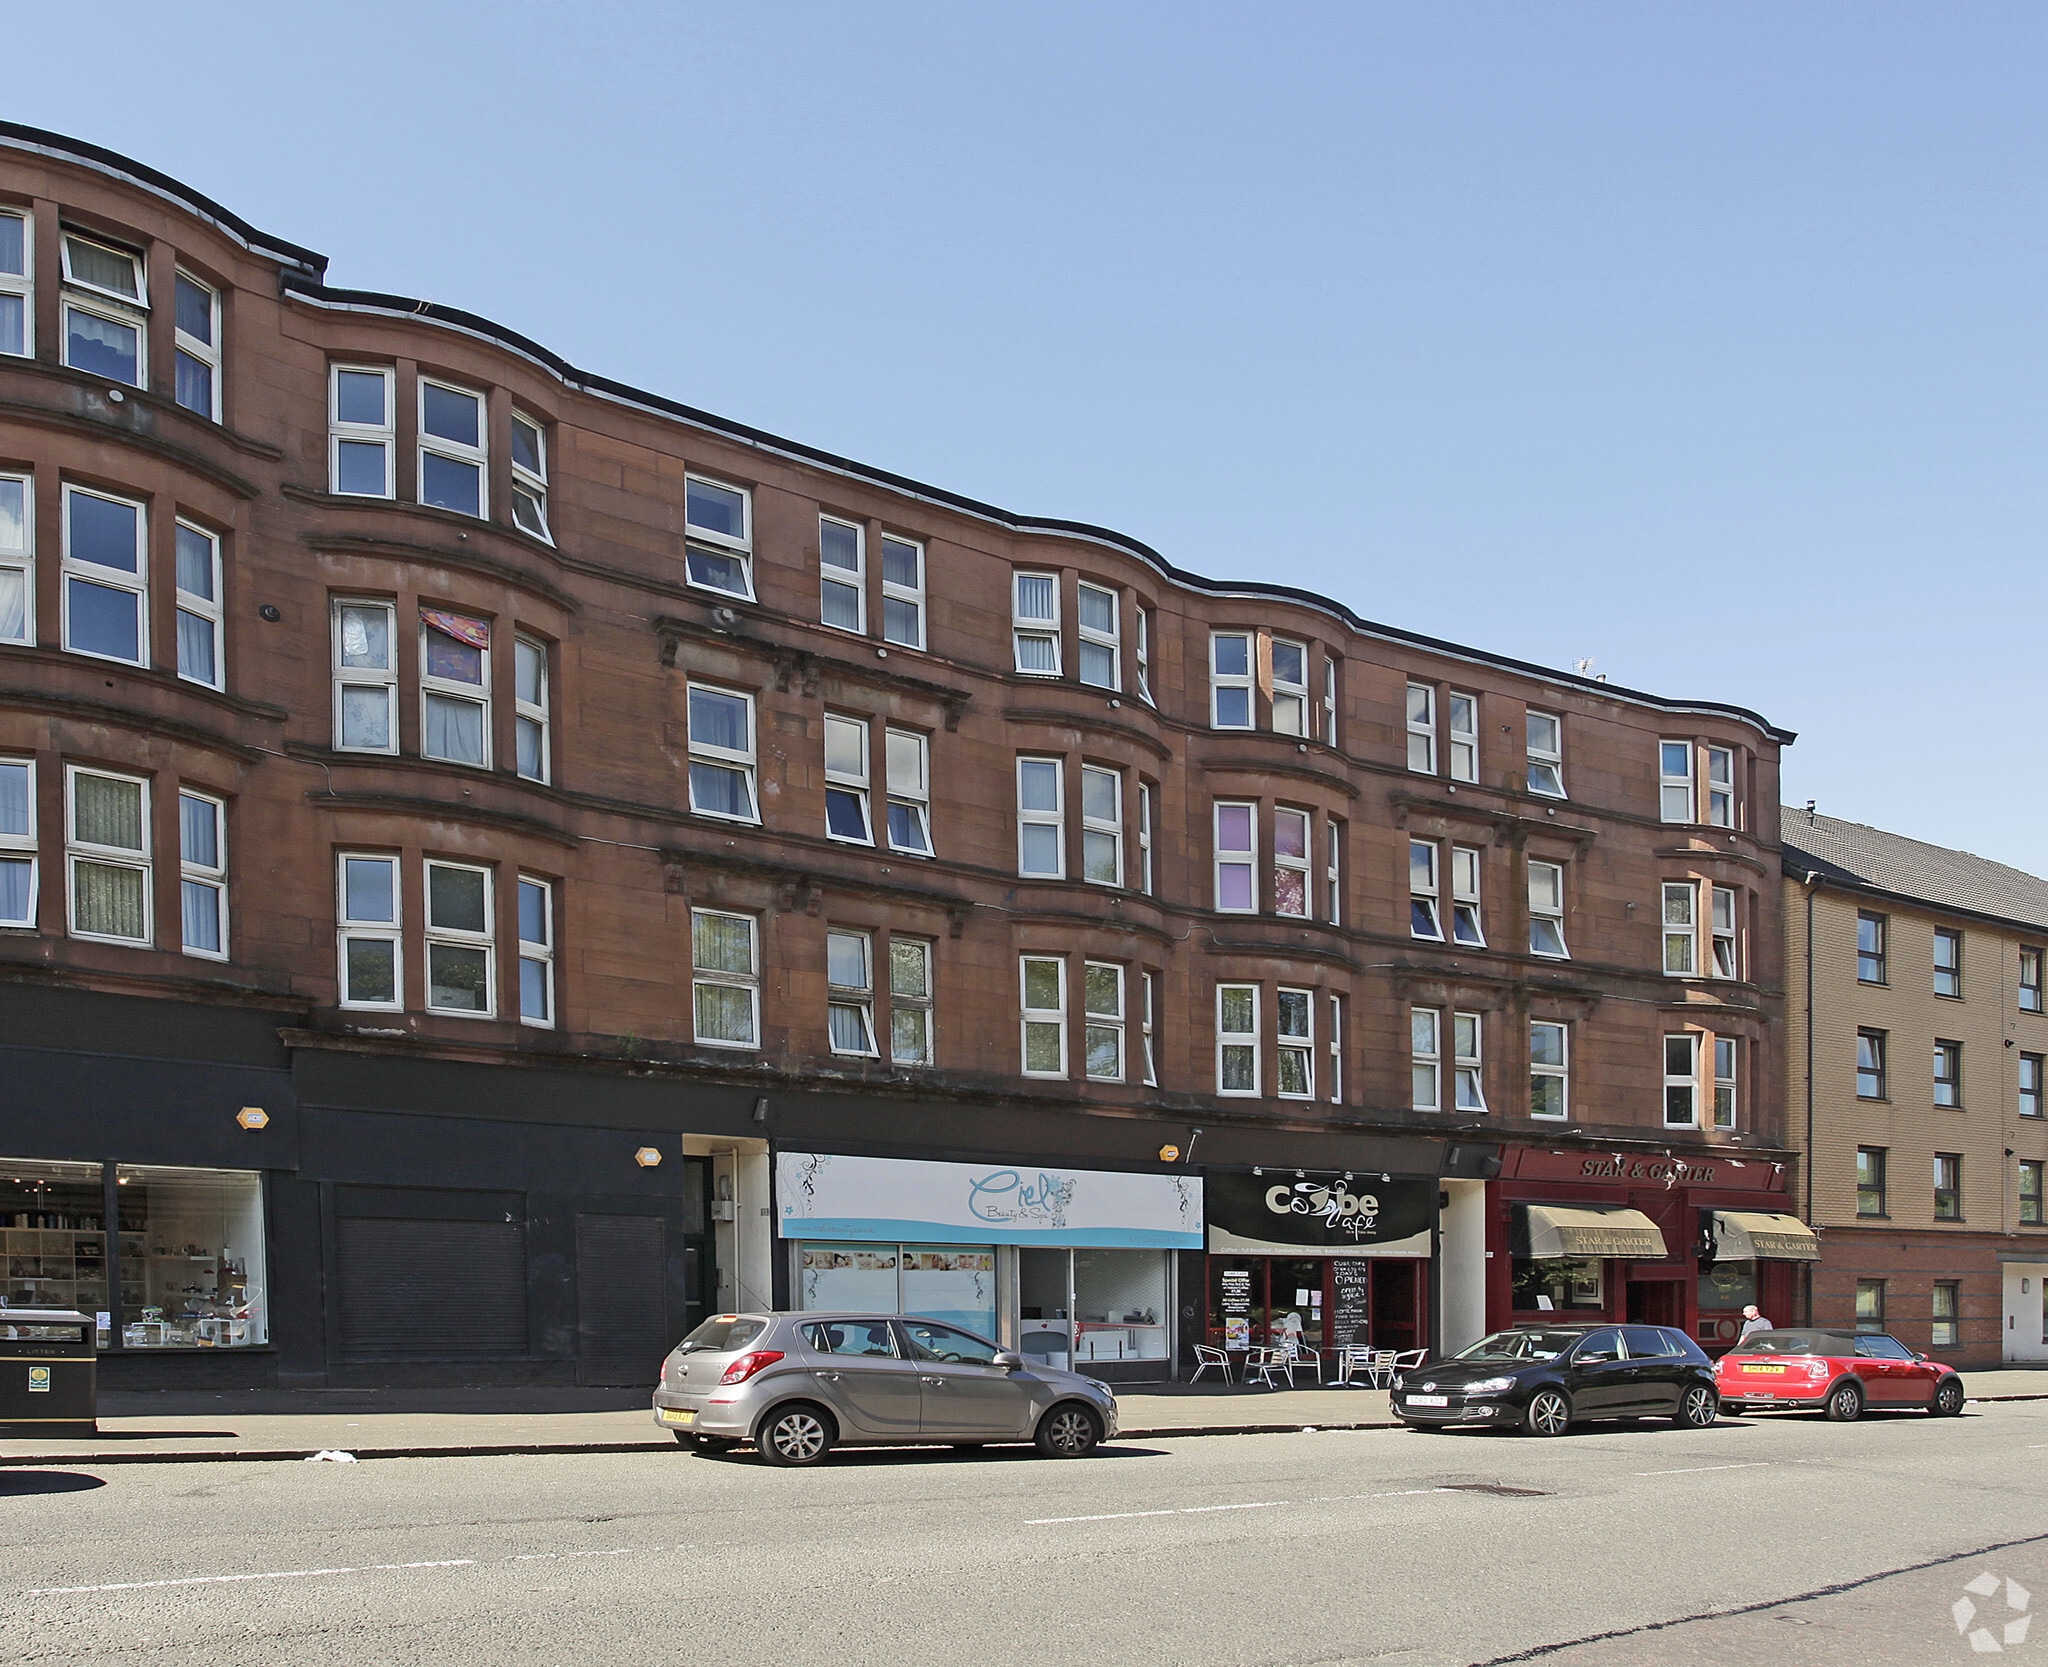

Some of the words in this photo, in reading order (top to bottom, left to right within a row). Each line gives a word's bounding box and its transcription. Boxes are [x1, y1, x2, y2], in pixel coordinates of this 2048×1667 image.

[1581, 1159, 1626, 1178] STAR
[1629, 1163, 1645, 1179] &
[1648, 1163, 1717, 1182] GARTER
[968, 1169, 1051, 1223] Ciel
[985, 1205, 1018, 1223] Beauty
[1019, 1206, 1029, 1219] &
[1029, 1207, 1049, 1225] Spa
[1575, 1235, 1602, 1246] STAR
[1604, 1237, 1613, 1246] &
[1613, 1236, 1653, 1247] GARTER
[1754, 1239, 1777, 1250] STAR
[1777, 1241, 1785, 1250] &
[1785, 1242, 1818, 1252] GARTER
